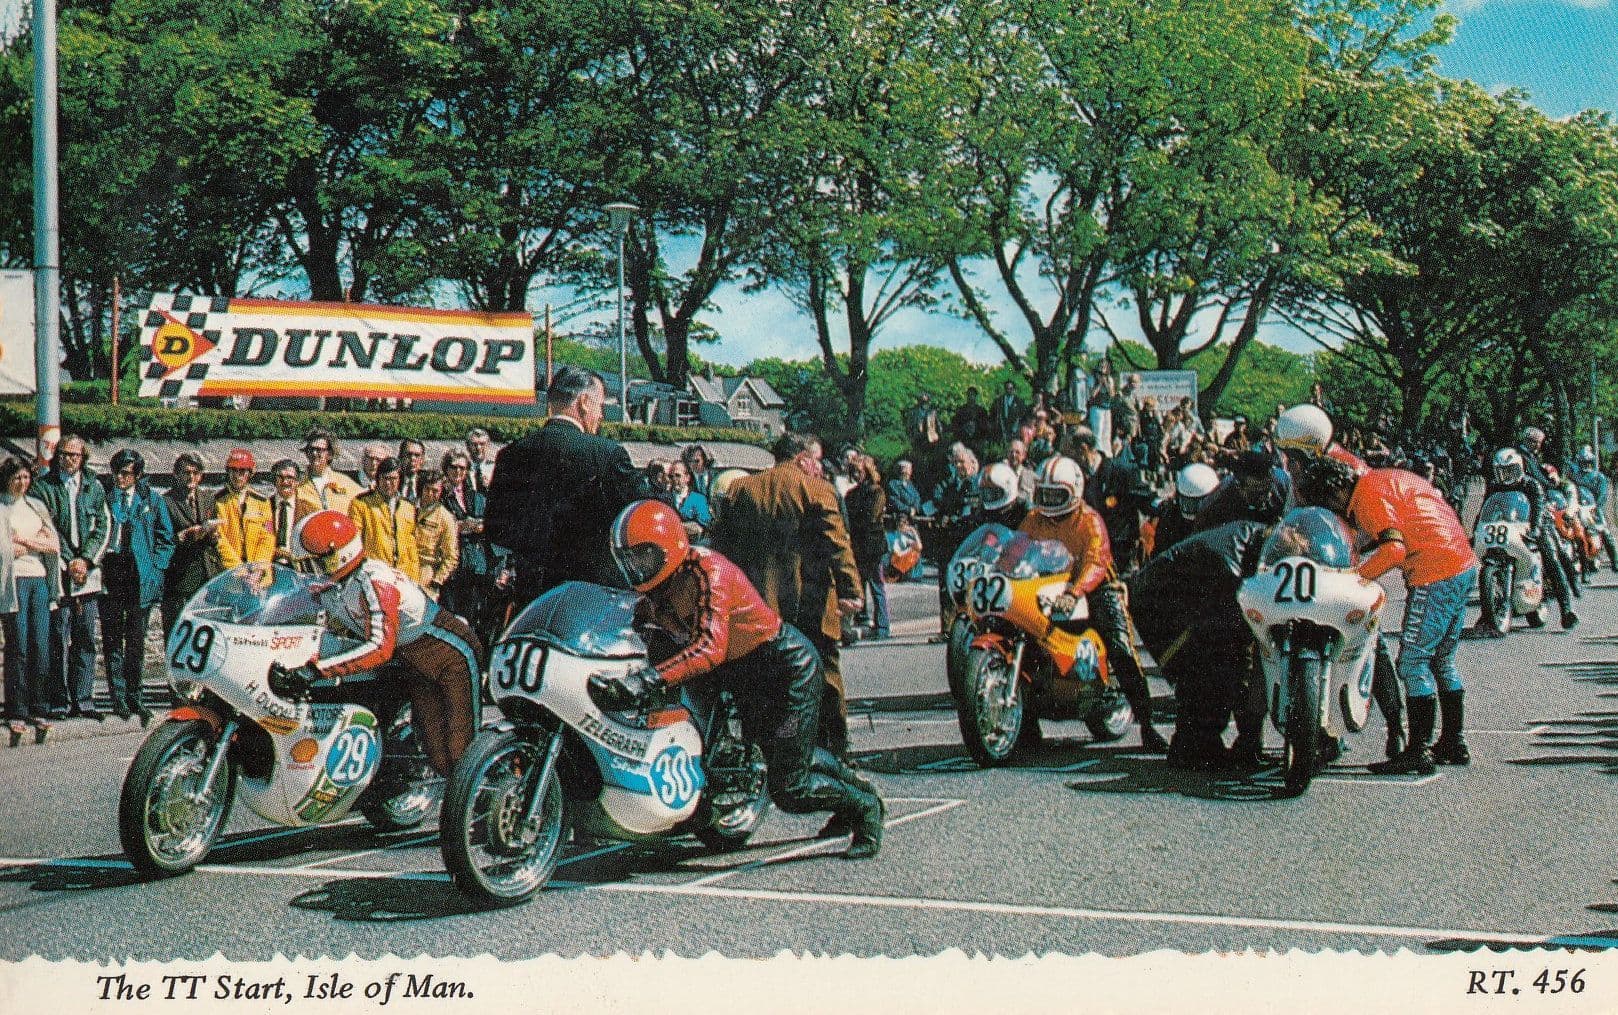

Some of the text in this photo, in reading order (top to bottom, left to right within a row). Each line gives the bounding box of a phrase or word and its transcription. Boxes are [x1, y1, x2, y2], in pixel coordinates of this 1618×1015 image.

[160, 335, 190, 356] D
[221, 327, 525, 375] DUNLOP
[1484, 524, 1508, 545] 38
[973, 576, 1006, 614] 32
[1274, 561, 1316, 603] 20
[171, 619, 215, 673] 29
[497, 641, 549, 692] 30
[331, 732, 369, 781] 29
[576, 713, 647, 757] TELEGRAPH
[656, 751, 693, 803] 30
